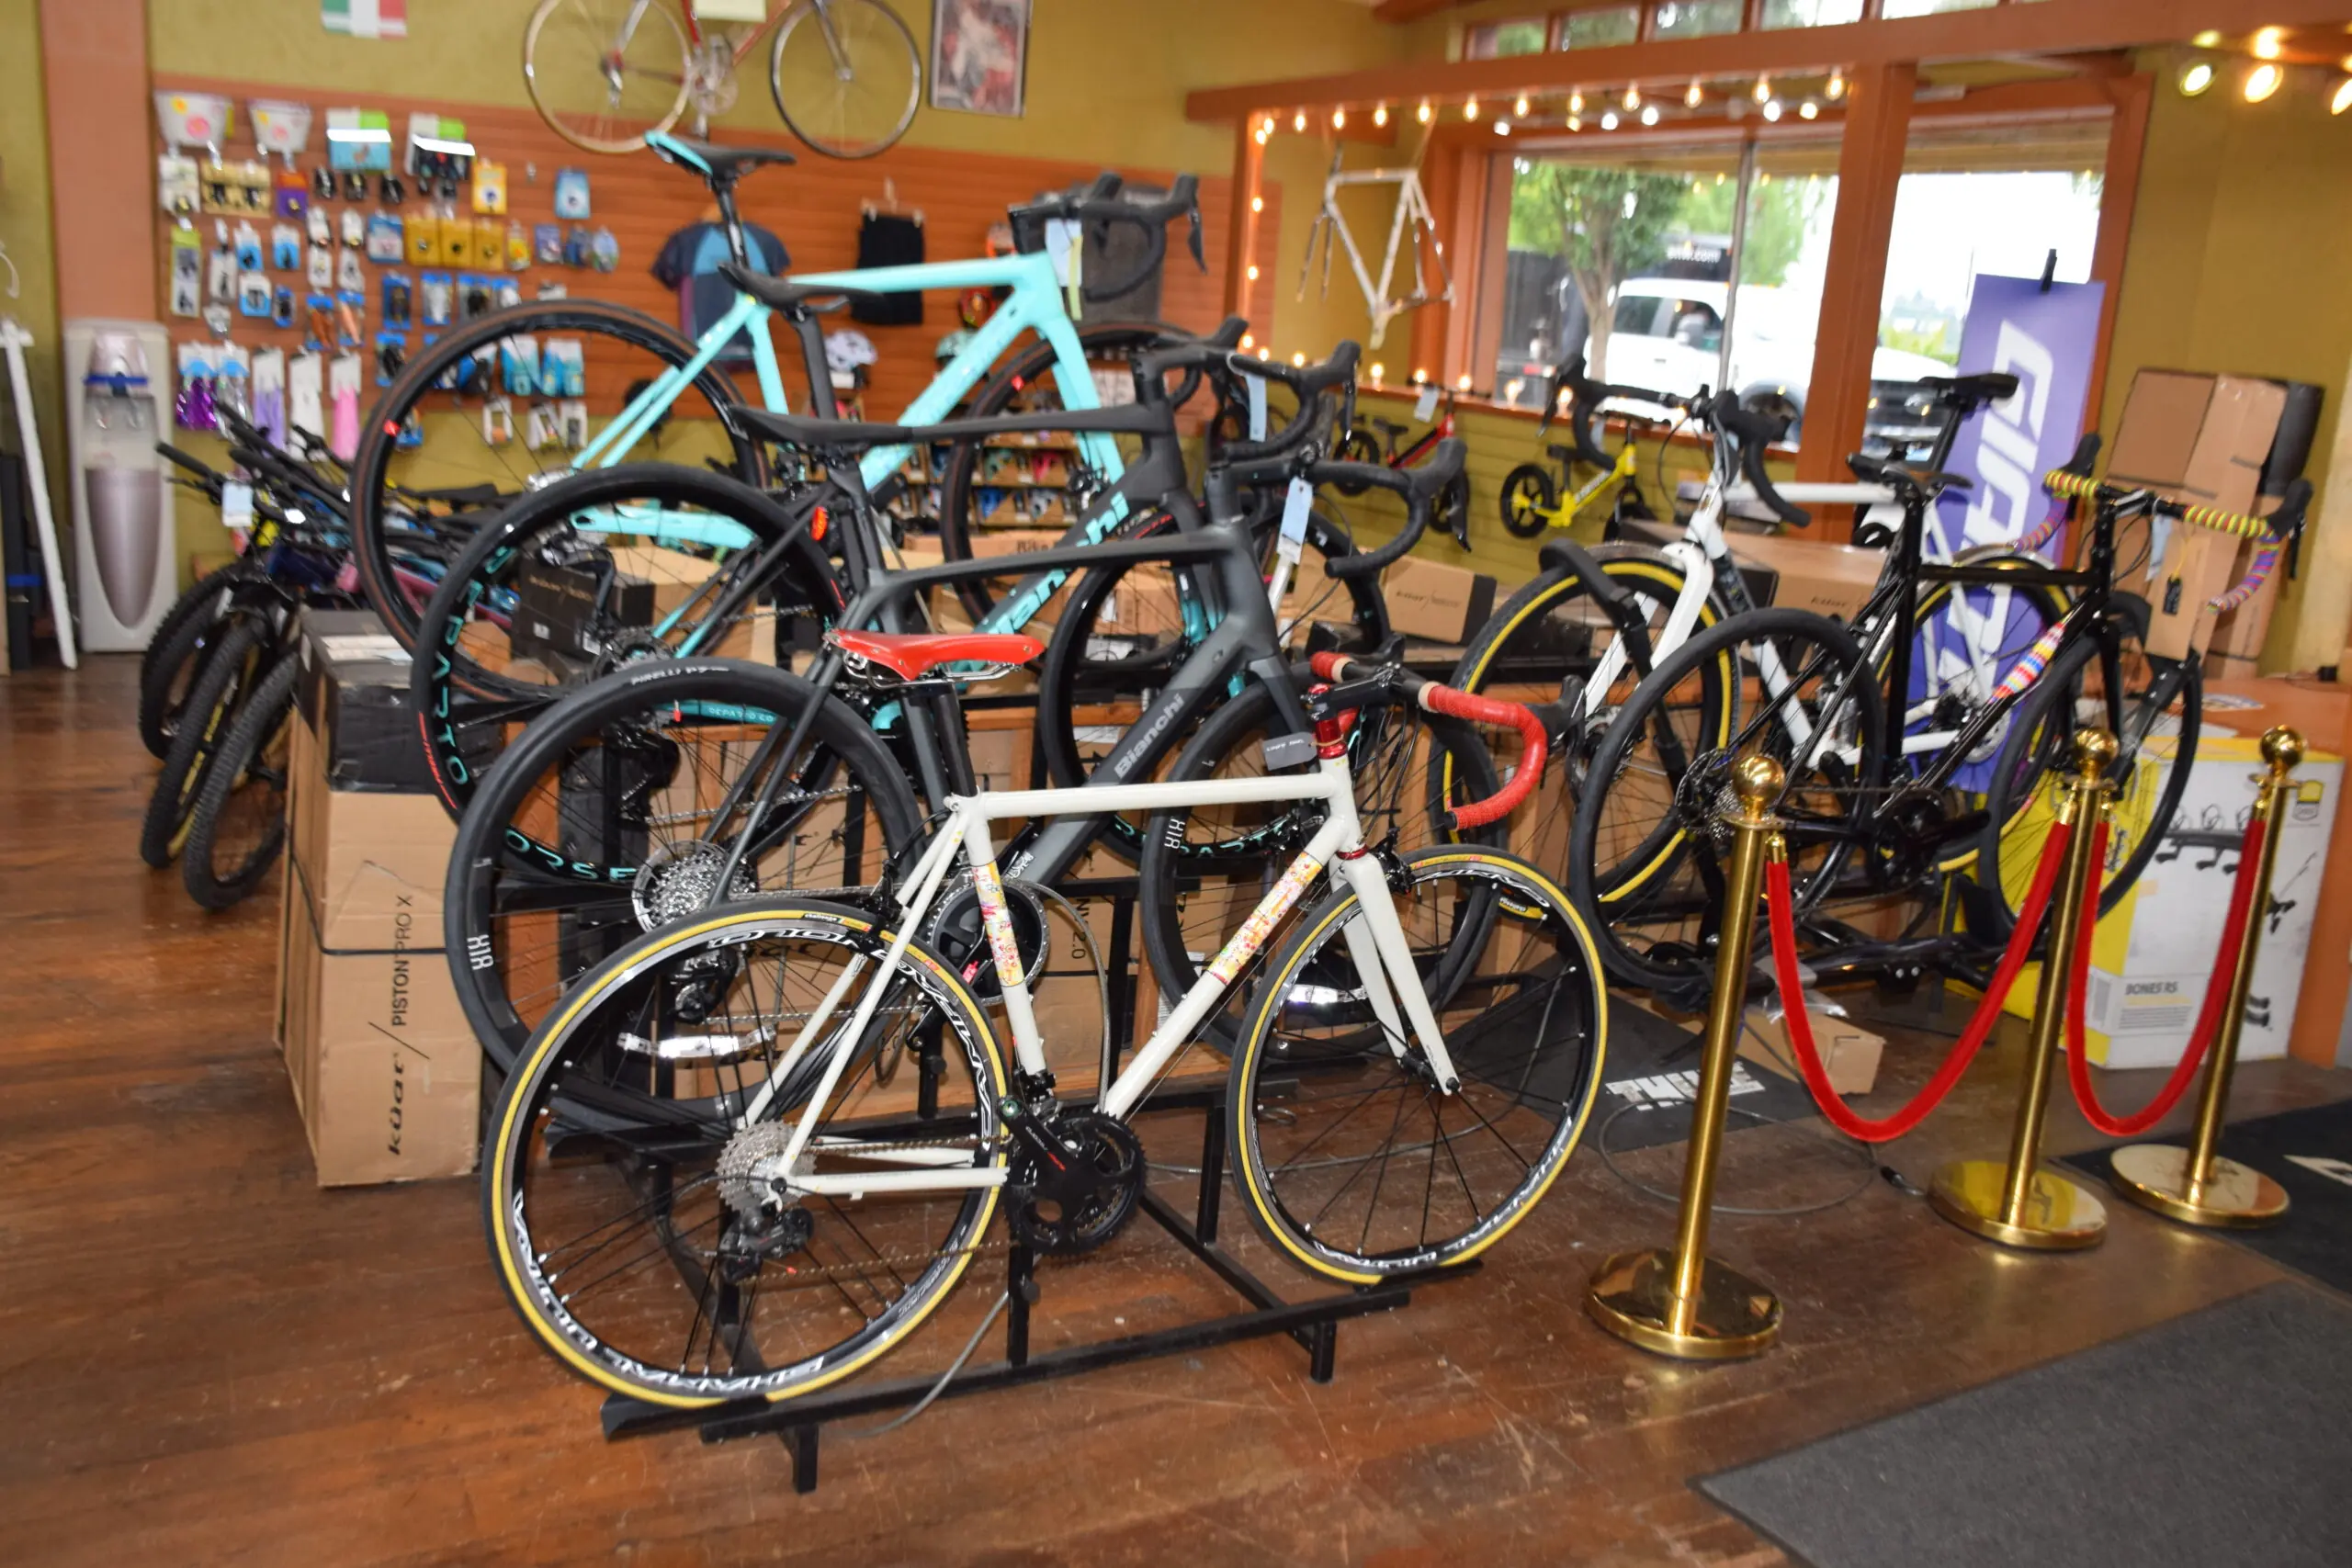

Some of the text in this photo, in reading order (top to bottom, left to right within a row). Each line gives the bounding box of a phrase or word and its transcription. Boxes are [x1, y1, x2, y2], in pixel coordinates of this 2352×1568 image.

[1114, 693, 1185, 780] Bianchi
[505, 829, 638, 882] ORSE
[391, 894, 413, 1027] PISTON PRO X
[1604, 1061, 1766, 1111] THUE
